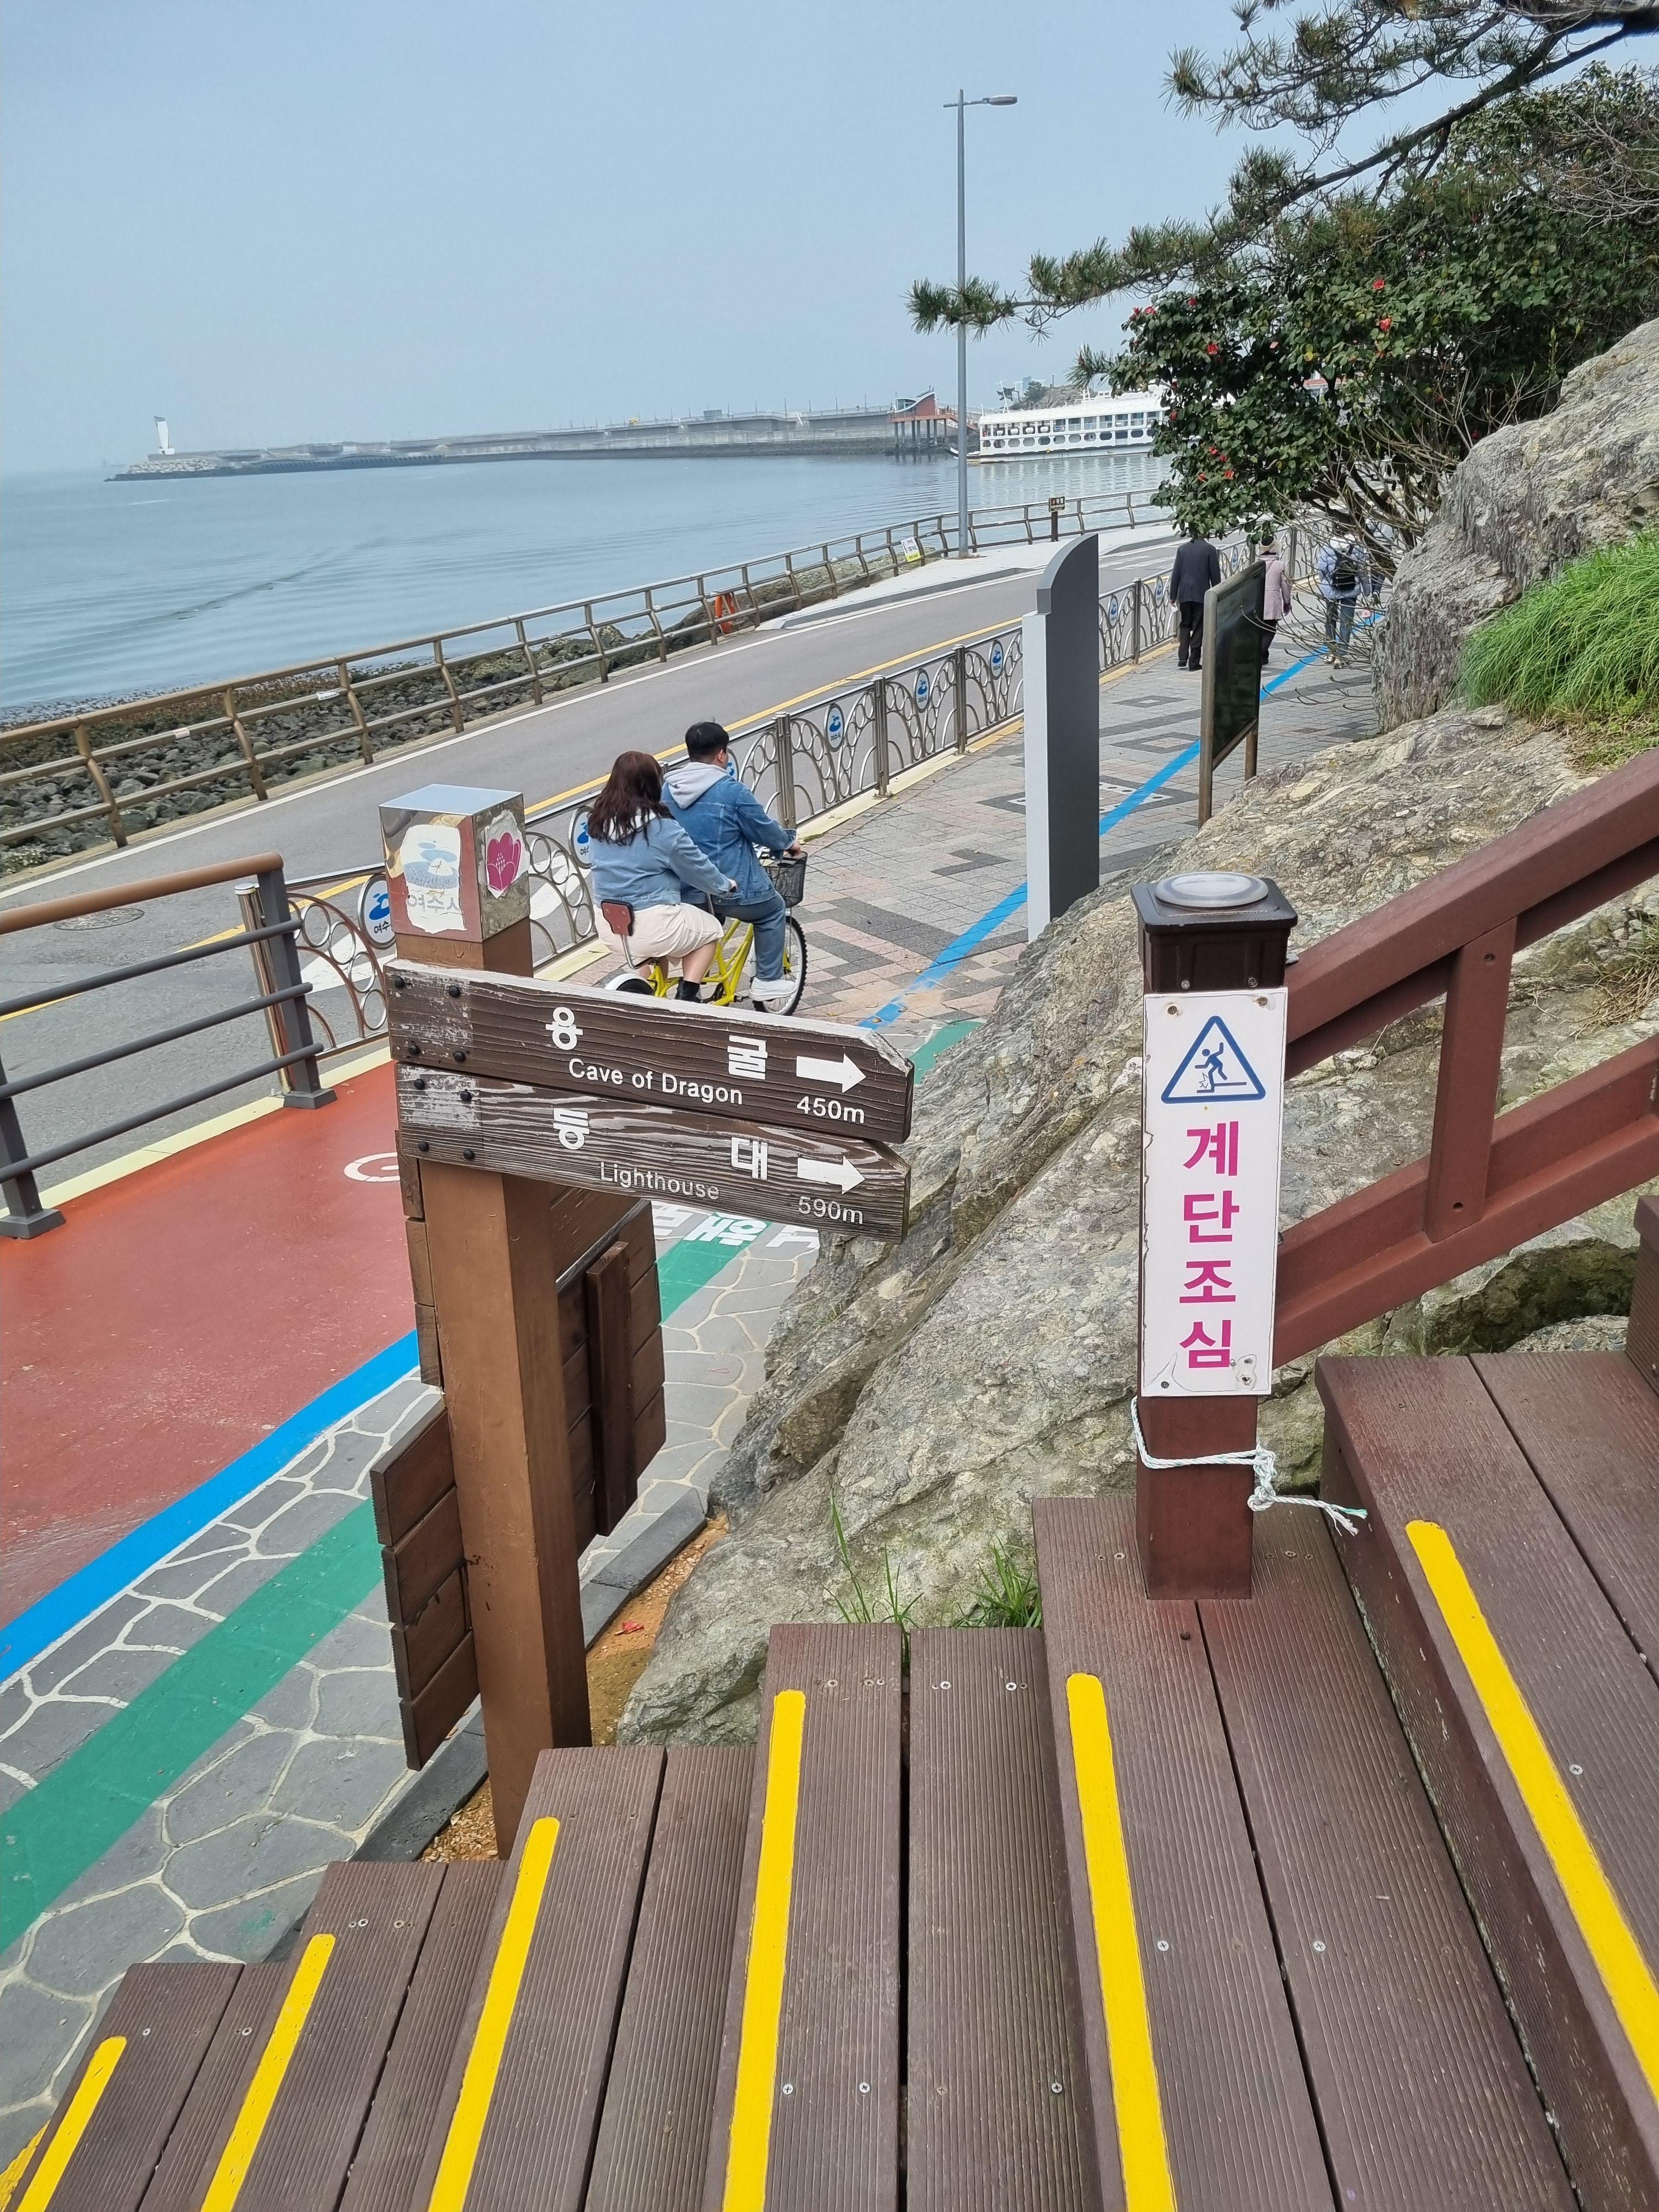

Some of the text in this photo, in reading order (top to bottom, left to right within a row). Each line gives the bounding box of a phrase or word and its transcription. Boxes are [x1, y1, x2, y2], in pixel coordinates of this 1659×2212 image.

[374, 920, 391, 933] 여수
[568, 1058, 743, 1105] Cave of Dragon
[797, 1096, 865, 1124] 450m
[600, 1162, 720, 1200] Lighthouse
[798, 1196, 864, 1224] 590m
